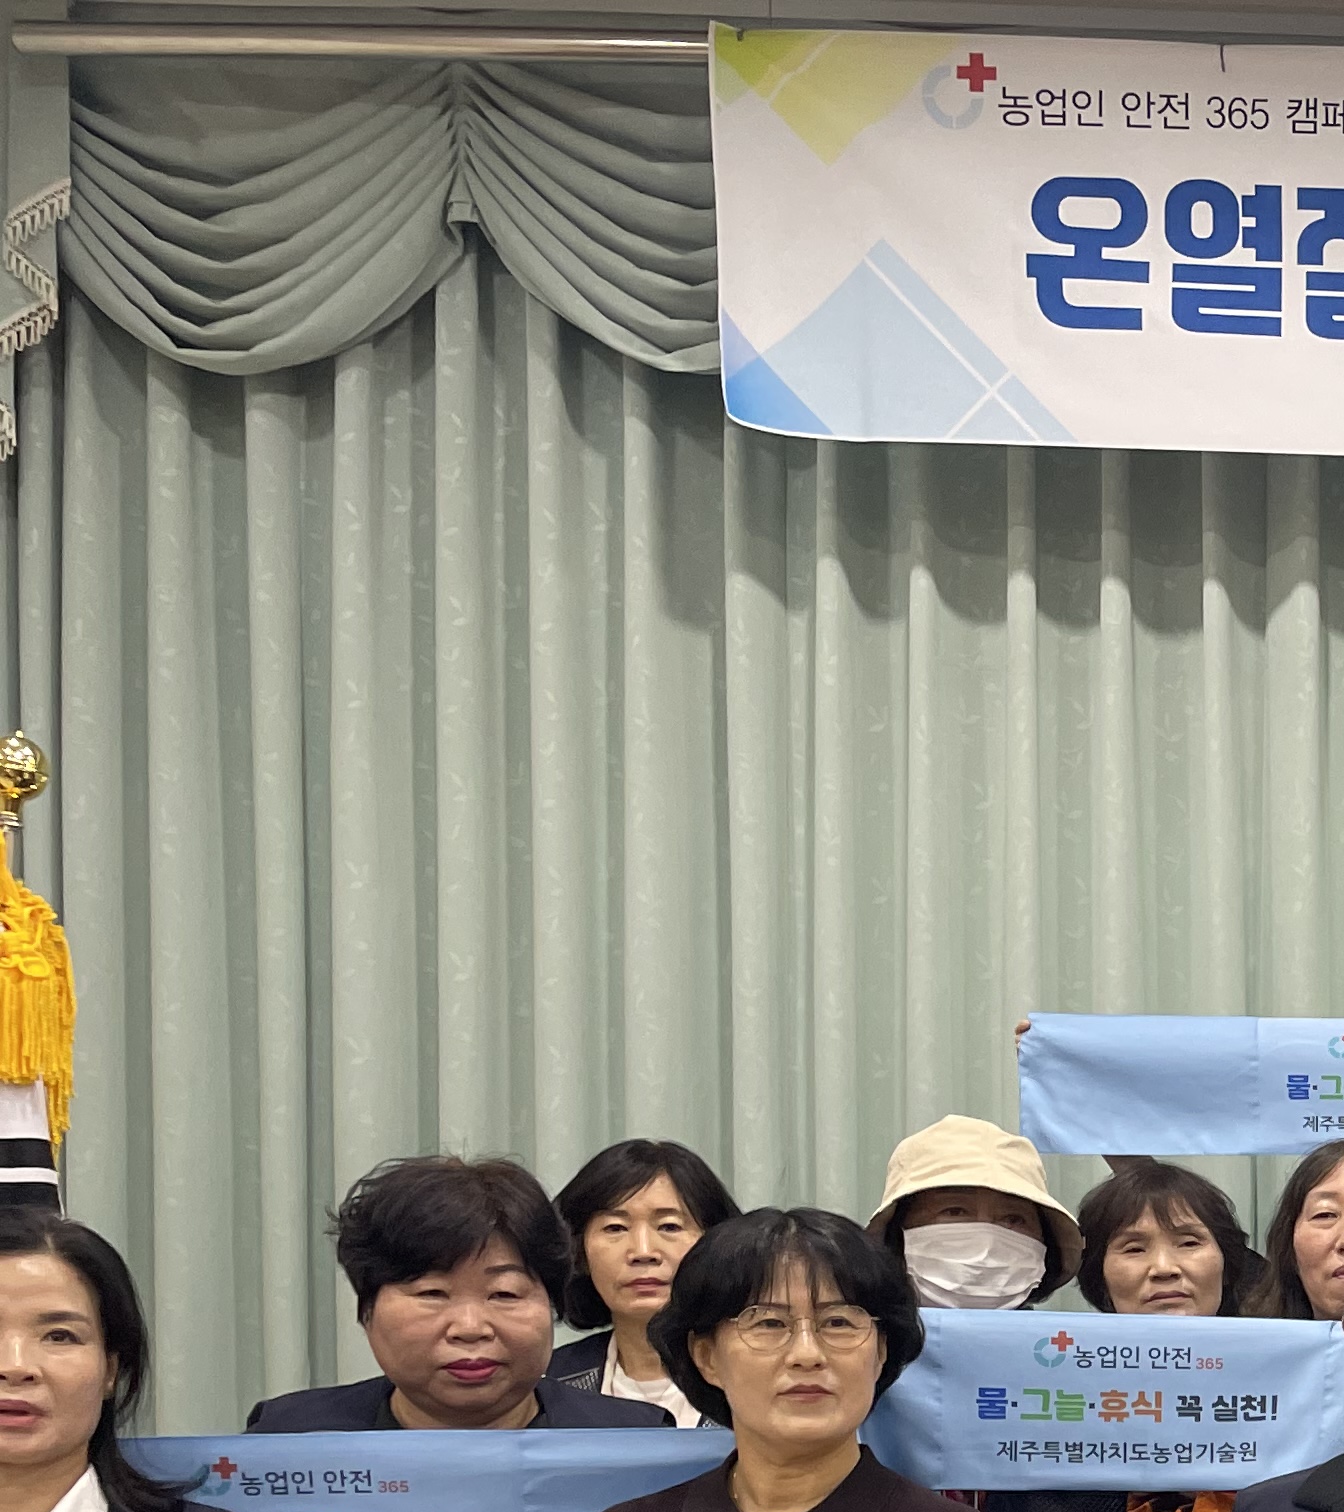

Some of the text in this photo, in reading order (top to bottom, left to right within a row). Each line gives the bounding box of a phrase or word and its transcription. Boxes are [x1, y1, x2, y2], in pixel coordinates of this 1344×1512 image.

[998, 85, 1107, 129] 농업인
[1120, 87, 1192, 132] 안전
[1206, 96, 1270, 131] 365
[1073, 1345, 1141, 1369] 농업인
[1176, 1393, 1202, 1423] 꼭
[1211, 1393, 1278, 1422] 실천!
[996, 1440, 1257, 1464] 제주특별자치도농업기술원
[239, 1470, 315, 1496] 농업인
